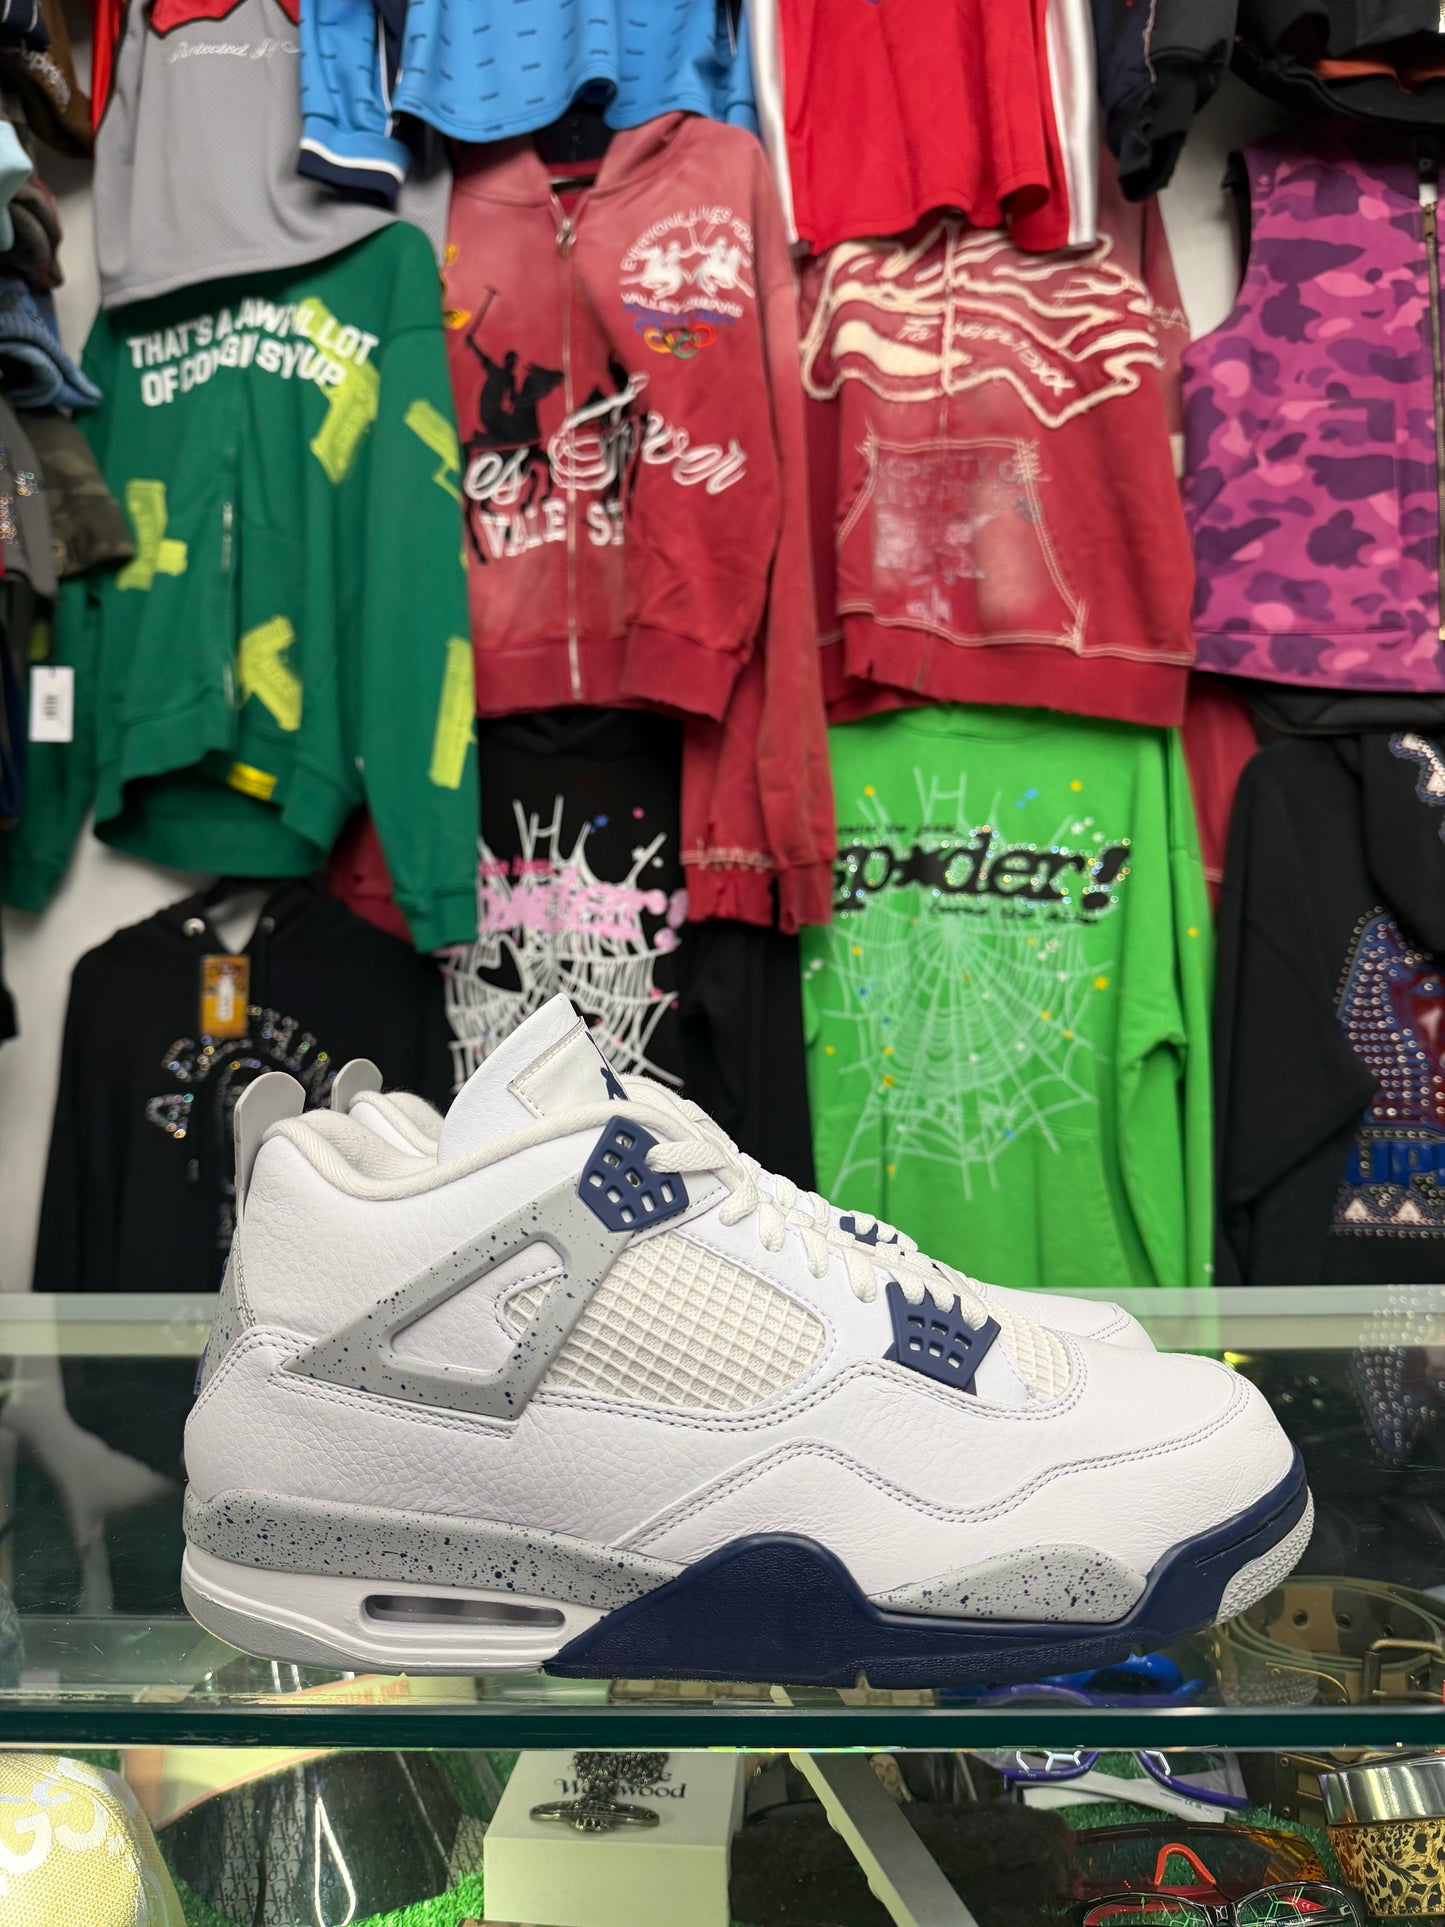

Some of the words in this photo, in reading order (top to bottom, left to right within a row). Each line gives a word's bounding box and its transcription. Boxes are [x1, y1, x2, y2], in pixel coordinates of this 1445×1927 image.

[127, 315, 213, 368] THAT'S
[215, 308, 233, 340] A
[317, 315, 379, 366] LOT
[140, 367, 178, 407] OF
